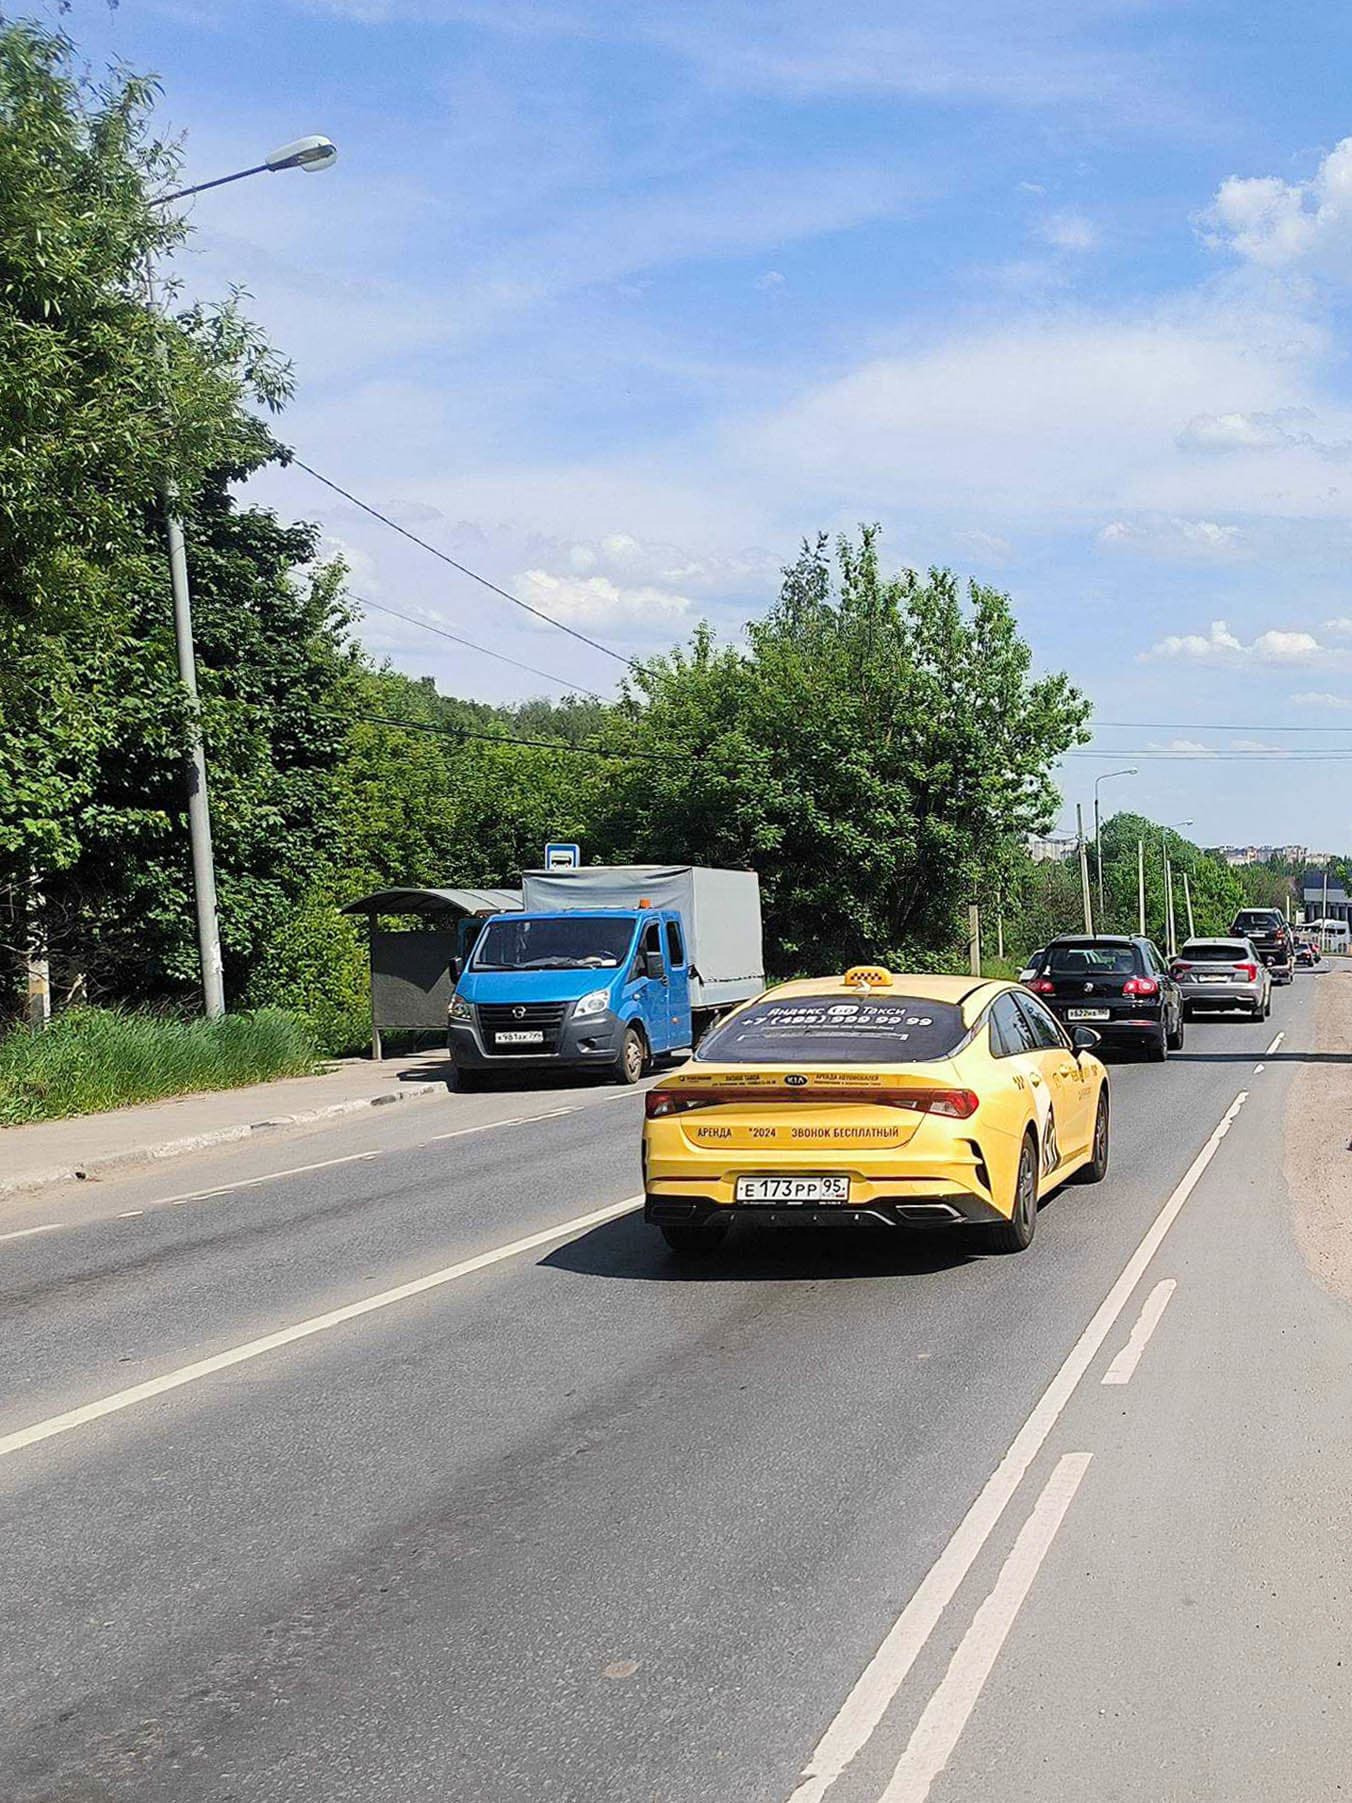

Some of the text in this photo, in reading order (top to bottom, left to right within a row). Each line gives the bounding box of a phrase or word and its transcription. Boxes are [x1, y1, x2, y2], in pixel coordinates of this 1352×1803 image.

[767, 1007, 825, 1016] Яндекс
[863, 1006, 906, 1015] Такси
[741, 1016, 934, 1026] +7 (495) 999 99 99
[786, 1076, 805, 1085] KIA
[697, 1128, 732, 1138] АРЕНДА
[791, 1128, 831, 1138] ЗВОНОК
[833, 1126, 899, 1138] БЕСПЛАТНЫЙ
[823, 1179, 842, 1193] 95
